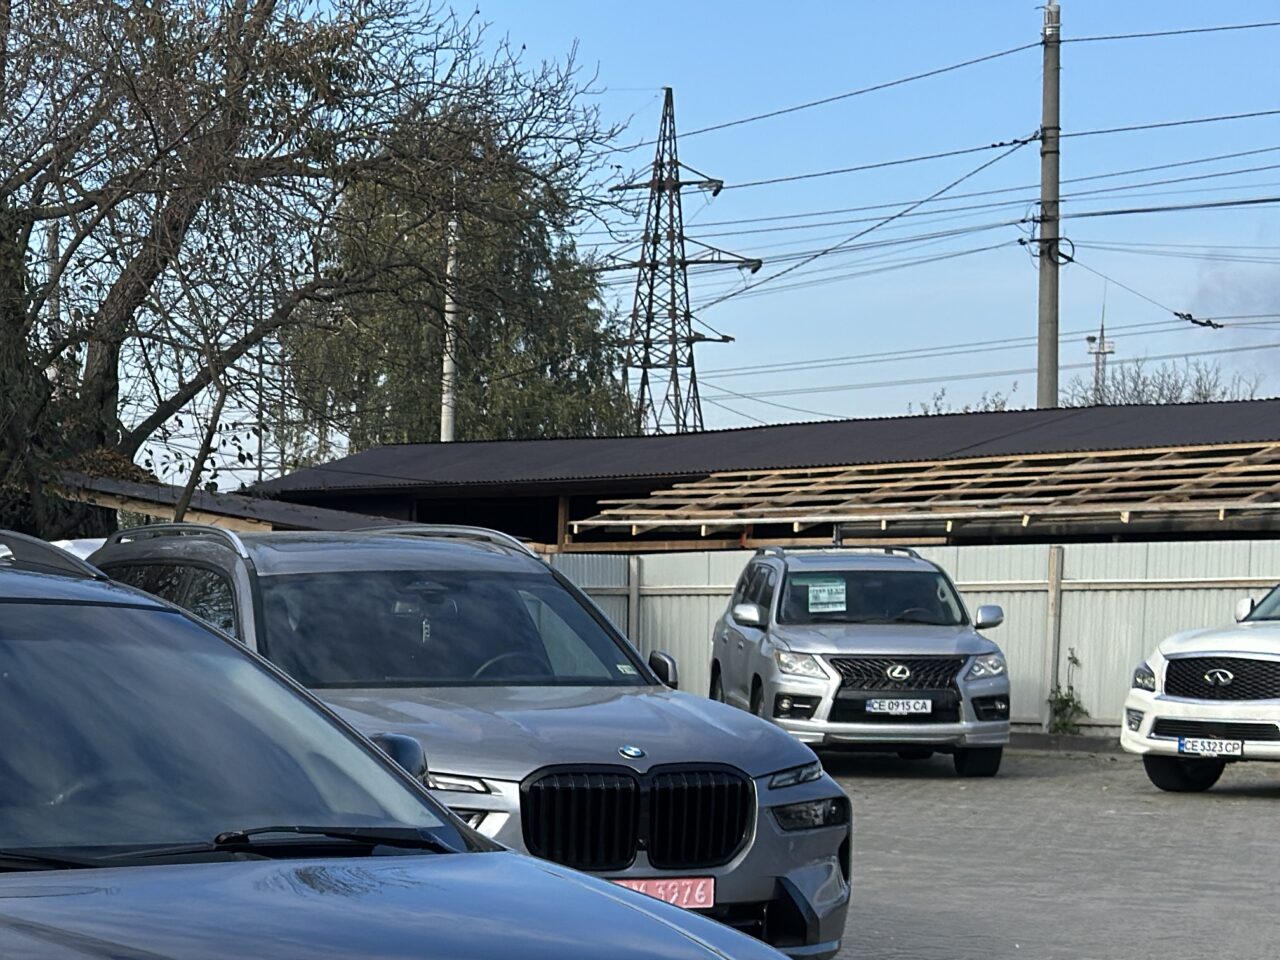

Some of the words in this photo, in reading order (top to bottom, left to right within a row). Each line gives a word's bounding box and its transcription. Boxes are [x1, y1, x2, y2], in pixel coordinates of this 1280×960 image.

[871, 700, 886, 711] CE
[887, 700, 911, 711] 0915
[913, 700, 928, 711] CA
[1184, 739, 1198, 751] CE
[1225, 742, 1240, 753] CP
